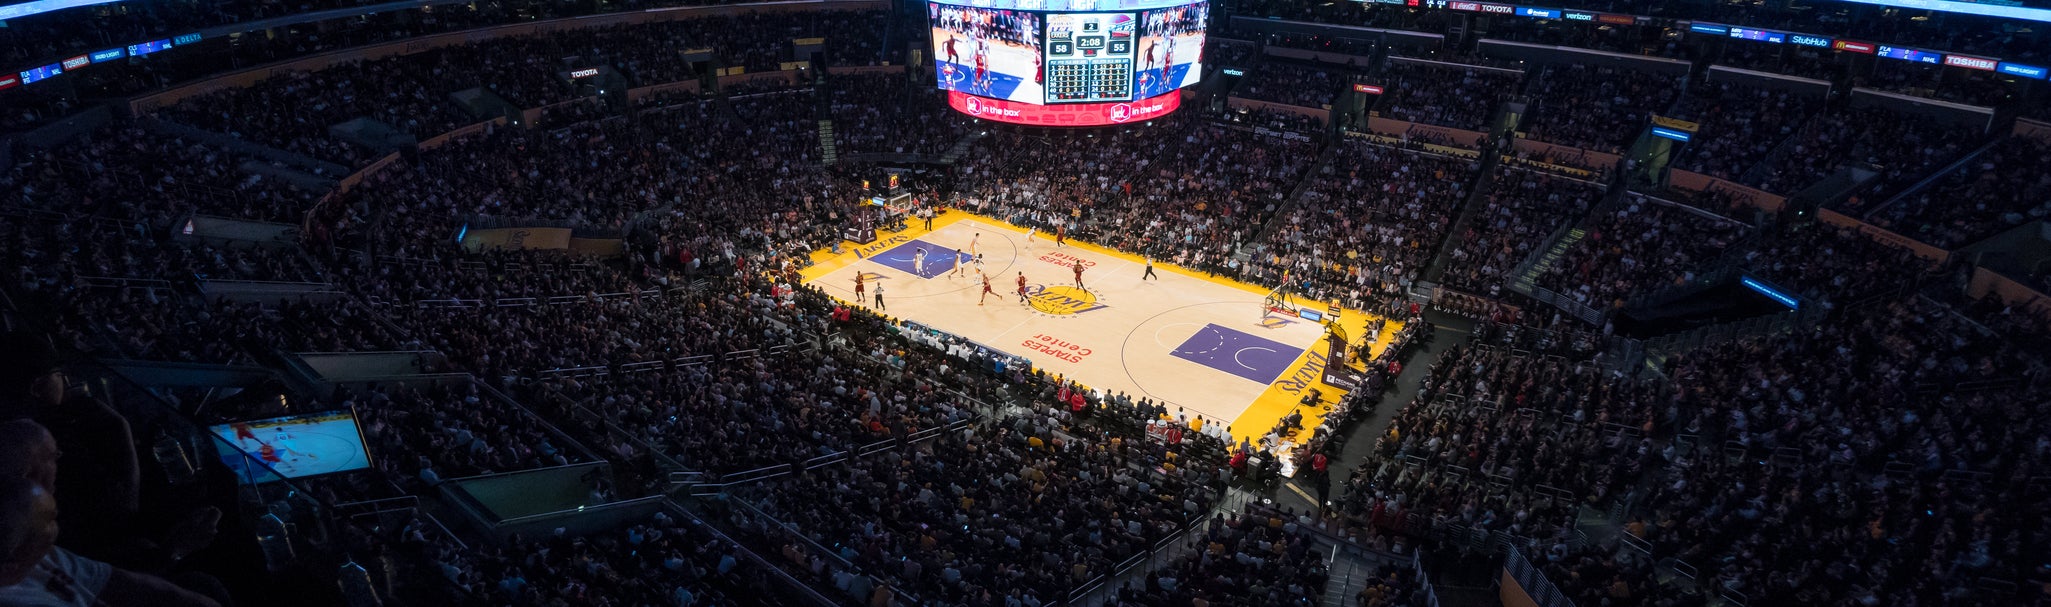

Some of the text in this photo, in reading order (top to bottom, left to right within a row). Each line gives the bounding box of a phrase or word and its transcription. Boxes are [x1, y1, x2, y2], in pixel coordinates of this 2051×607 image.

[1482, 4, 1513, 14] TOYOTA
[1566, 12, 1592, 21] verizon
[180, 34, 202, 43] DELTA
[1080, 38, 1101, 47] 2:08
[1792, 36, 1828, 47] StubHub
[1056, 45, 1067, 53] 58
[1114, 44, 1125, 52] 55
[63, 56, 90, 69] TOSHIBA
[1922, 56, 1937, 64] NHL
[1946, 55, 1996, 70] TOSHIBA
[571, 69, 598, 78] TOYOTA
[1223, 69, 1243, 77] verizon
[982, 104, 989, 113] in
[990, 106, 1003, 115] the
[1003, 108, 1020, 117] box
[1132, 107, 1139, 115] in
[1140, 106, 1152, 114] the
[853, 233, 909, 260] LAKERS
[1034, 333, 1092, 356] Center
[1022, 339, 1083, 364] STAPLES
[1274, 350, 1327, 396] LAKERS
